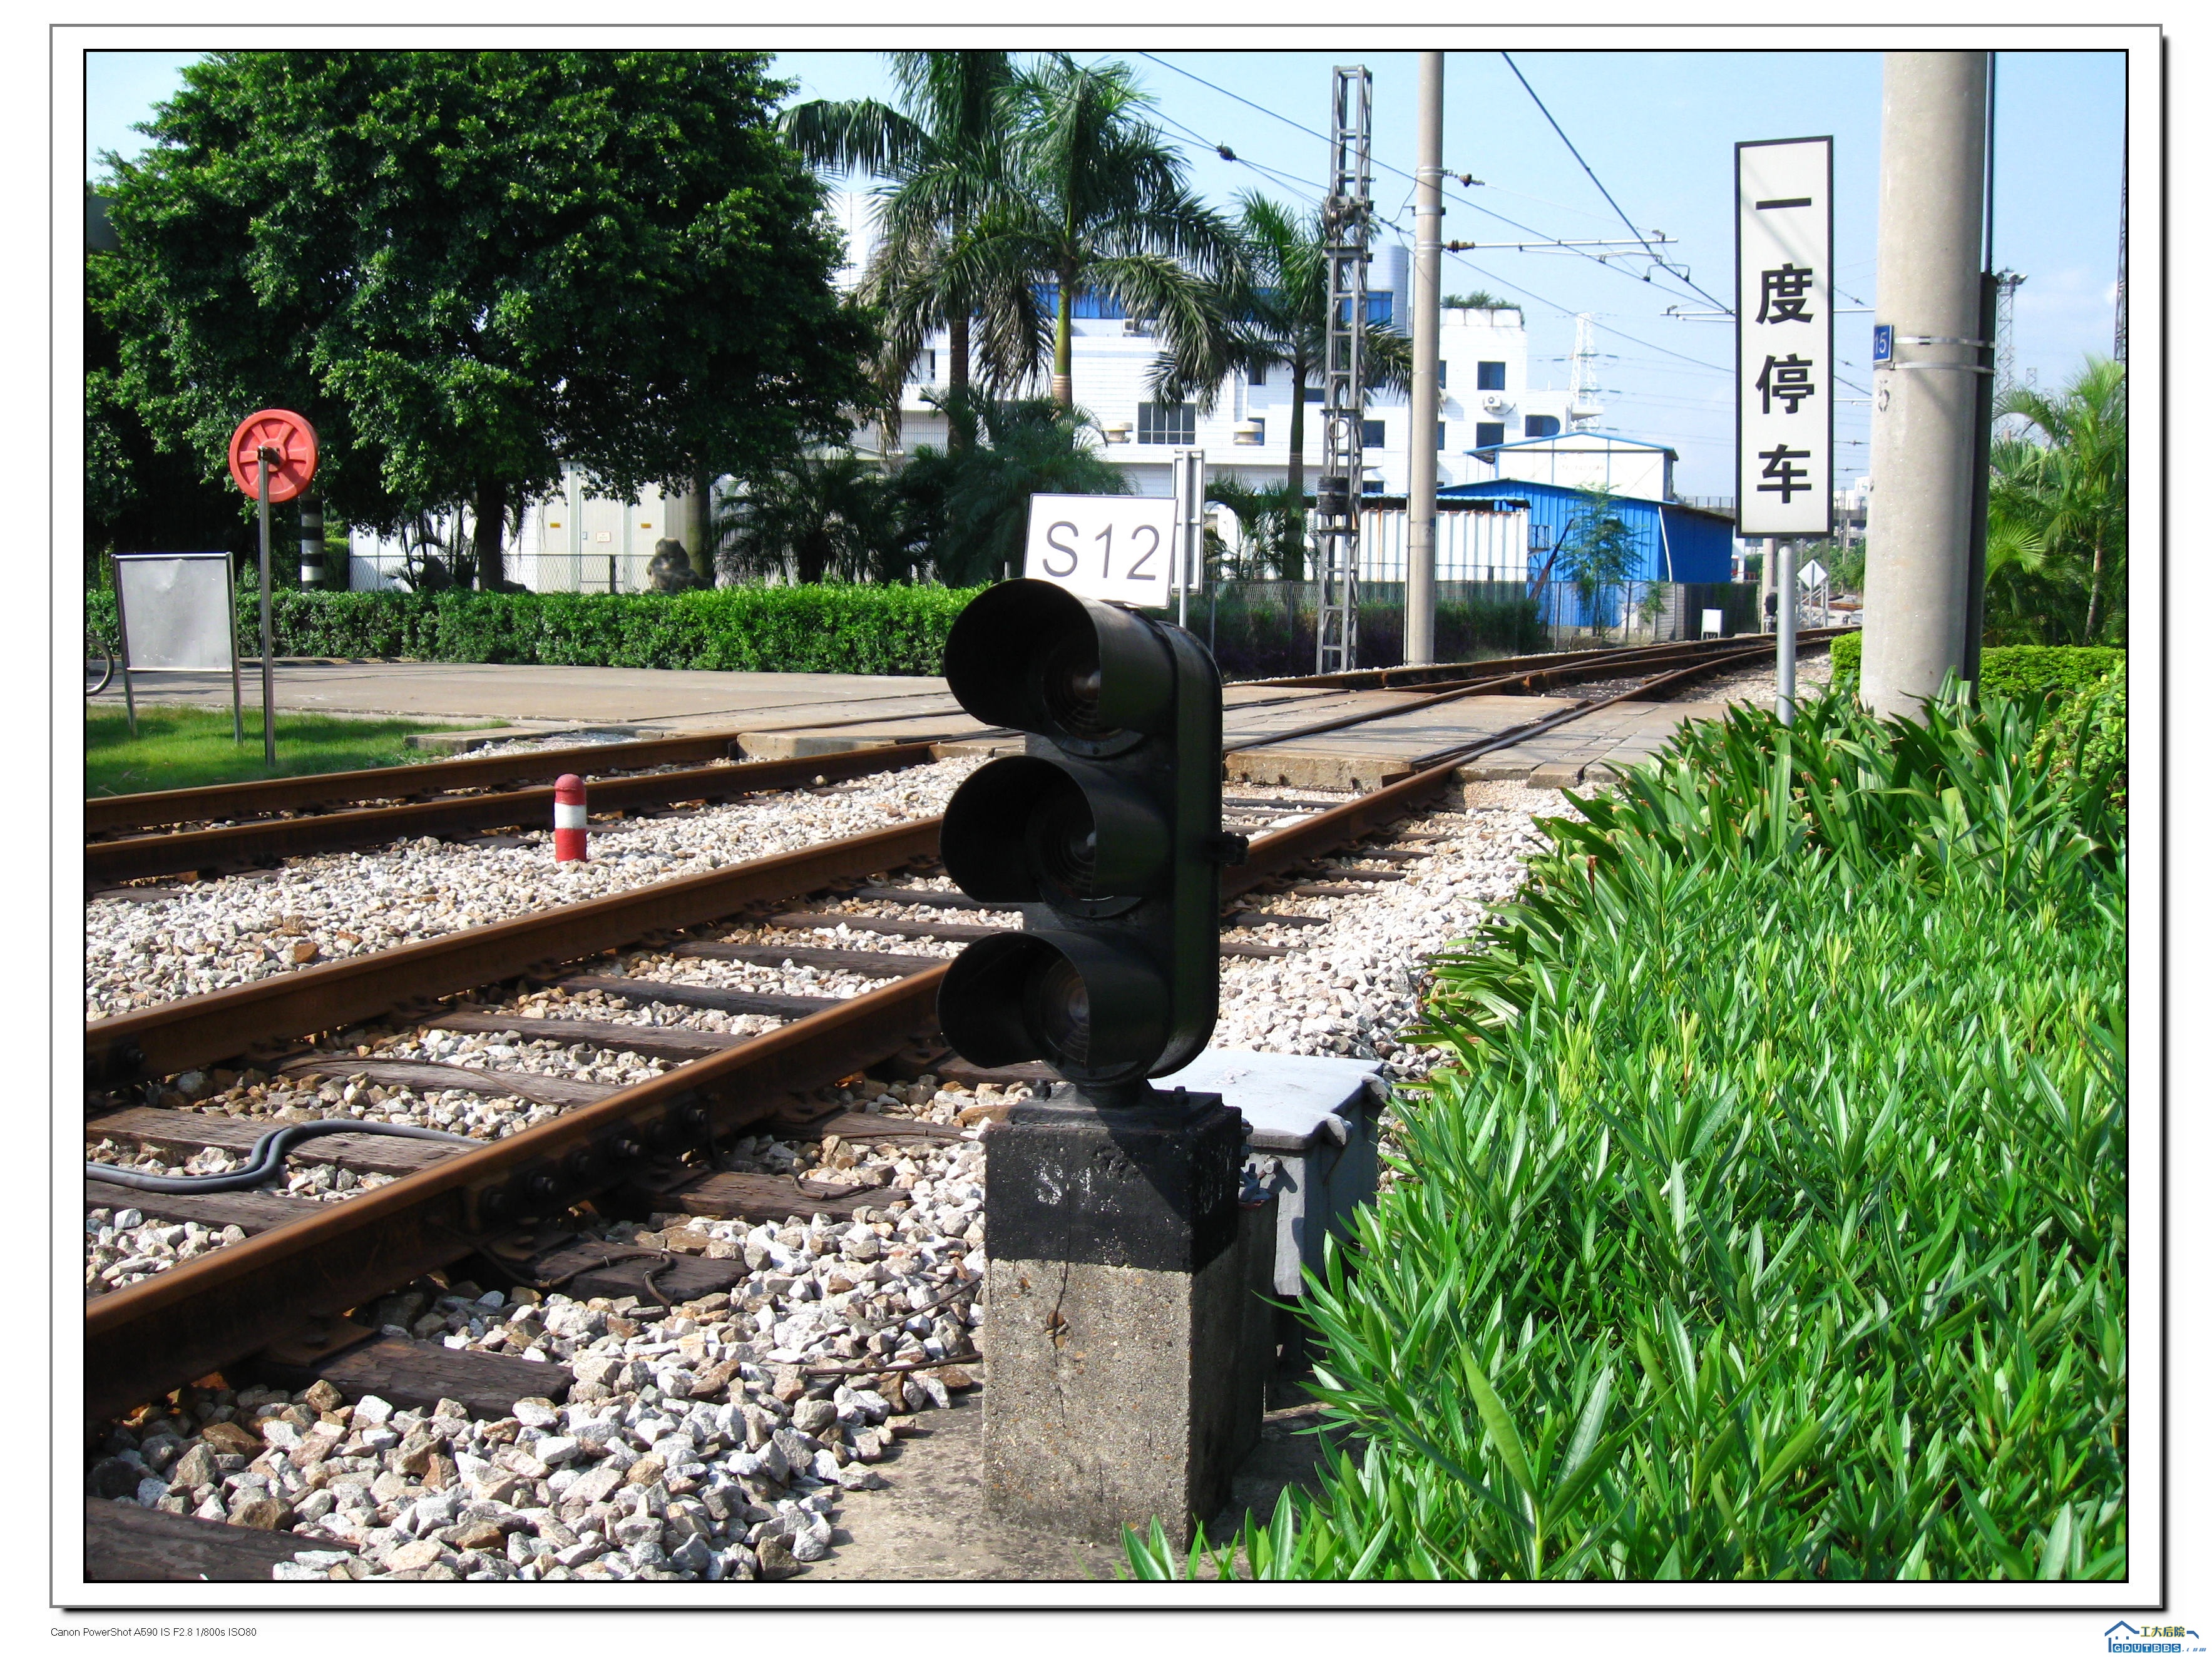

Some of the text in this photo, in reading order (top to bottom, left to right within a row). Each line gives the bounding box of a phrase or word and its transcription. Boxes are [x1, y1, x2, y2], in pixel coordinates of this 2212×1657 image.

[1754, 196, 1815, 504] 一度停车
[1042, 521, 1160, 581] S12
